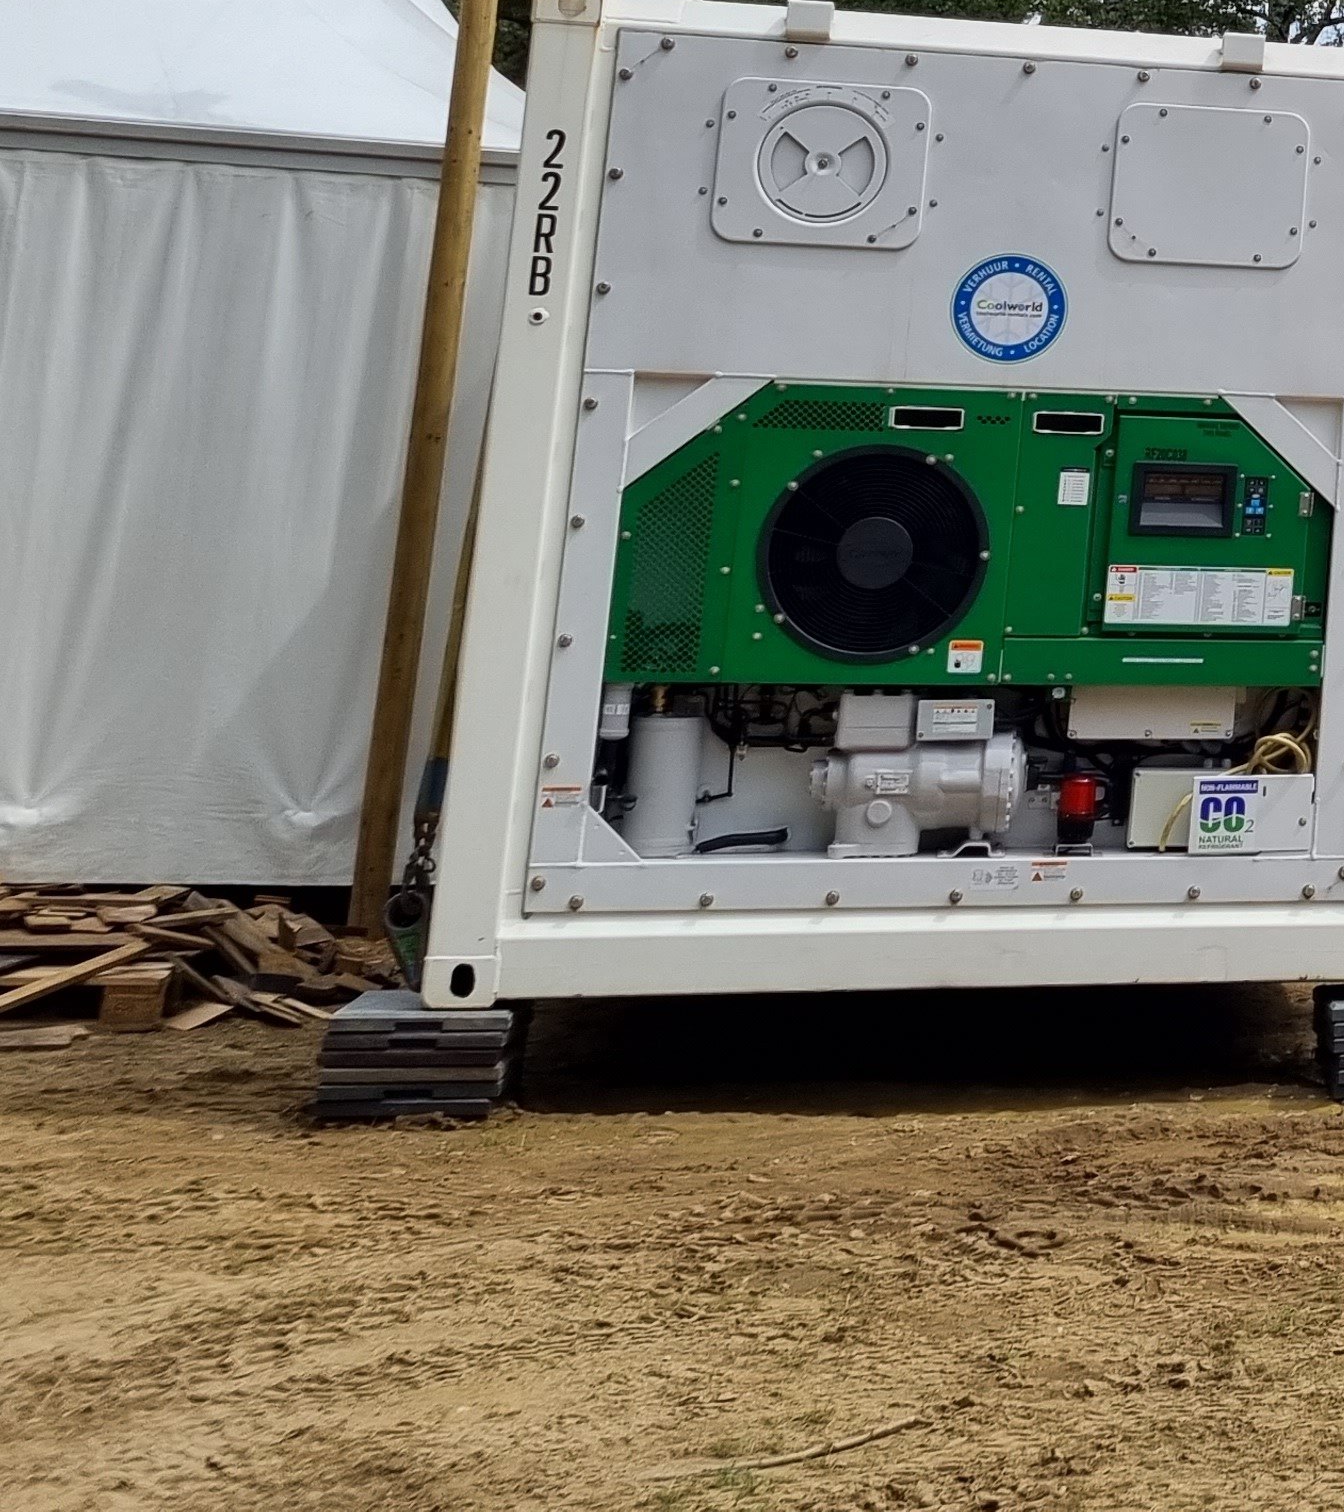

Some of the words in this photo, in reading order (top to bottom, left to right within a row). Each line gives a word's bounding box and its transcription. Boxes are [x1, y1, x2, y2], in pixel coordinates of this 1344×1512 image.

[529, 128, 566, 297] 22RB
[963, 261, 1009, 293] VERHUUR
[1025, 264, 1058, 297] RENTAL
[977, 299, 1043, 313] Coolworld
[958, 311, 1004, 357] VERMIETUNG
[1023, 313, 1060, 354] LOCATION
[1198, 835, 1243, 844] NATURAL
